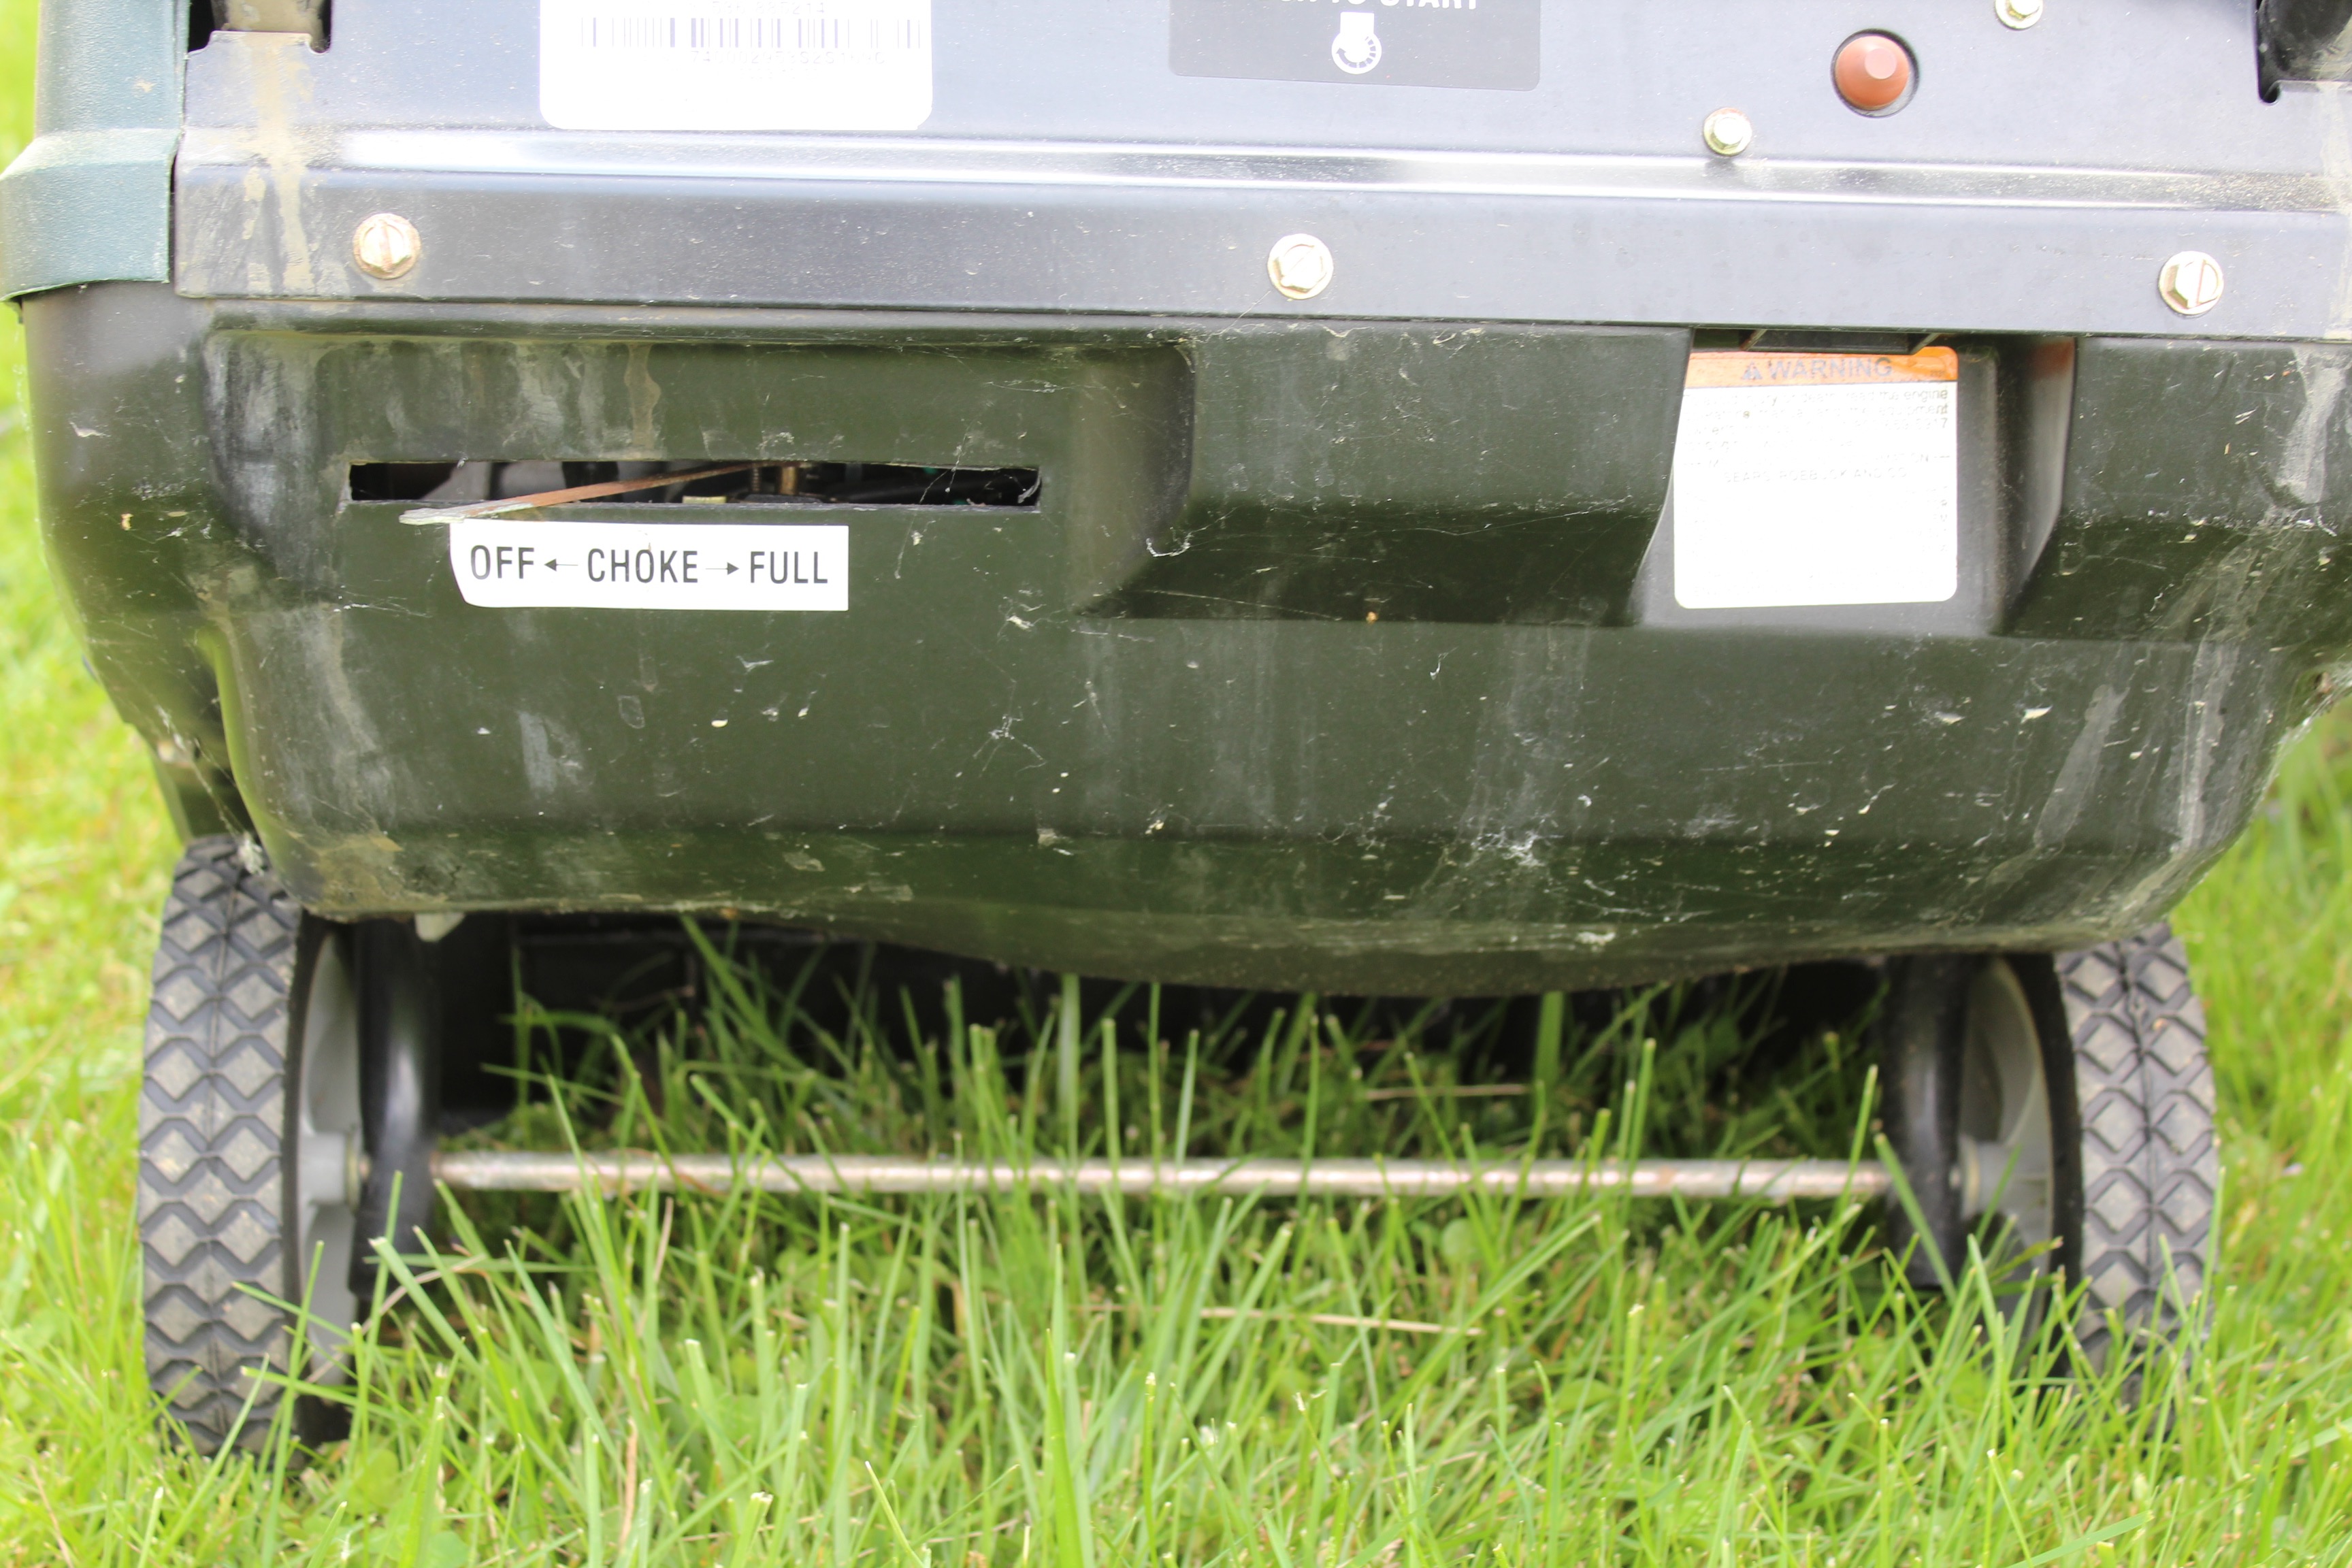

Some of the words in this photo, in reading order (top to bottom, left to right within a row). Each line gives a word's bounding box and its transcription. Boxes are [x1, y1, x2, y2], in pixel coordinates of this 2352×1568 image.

[1768, 357, 1893, 379] WARNING
[1903, 389, 1950, 403] engine
[470, 544, 535, 580] OFF
[587, 548, 699, 584] CHOKE
[750, 551, 829, 585] FULL
